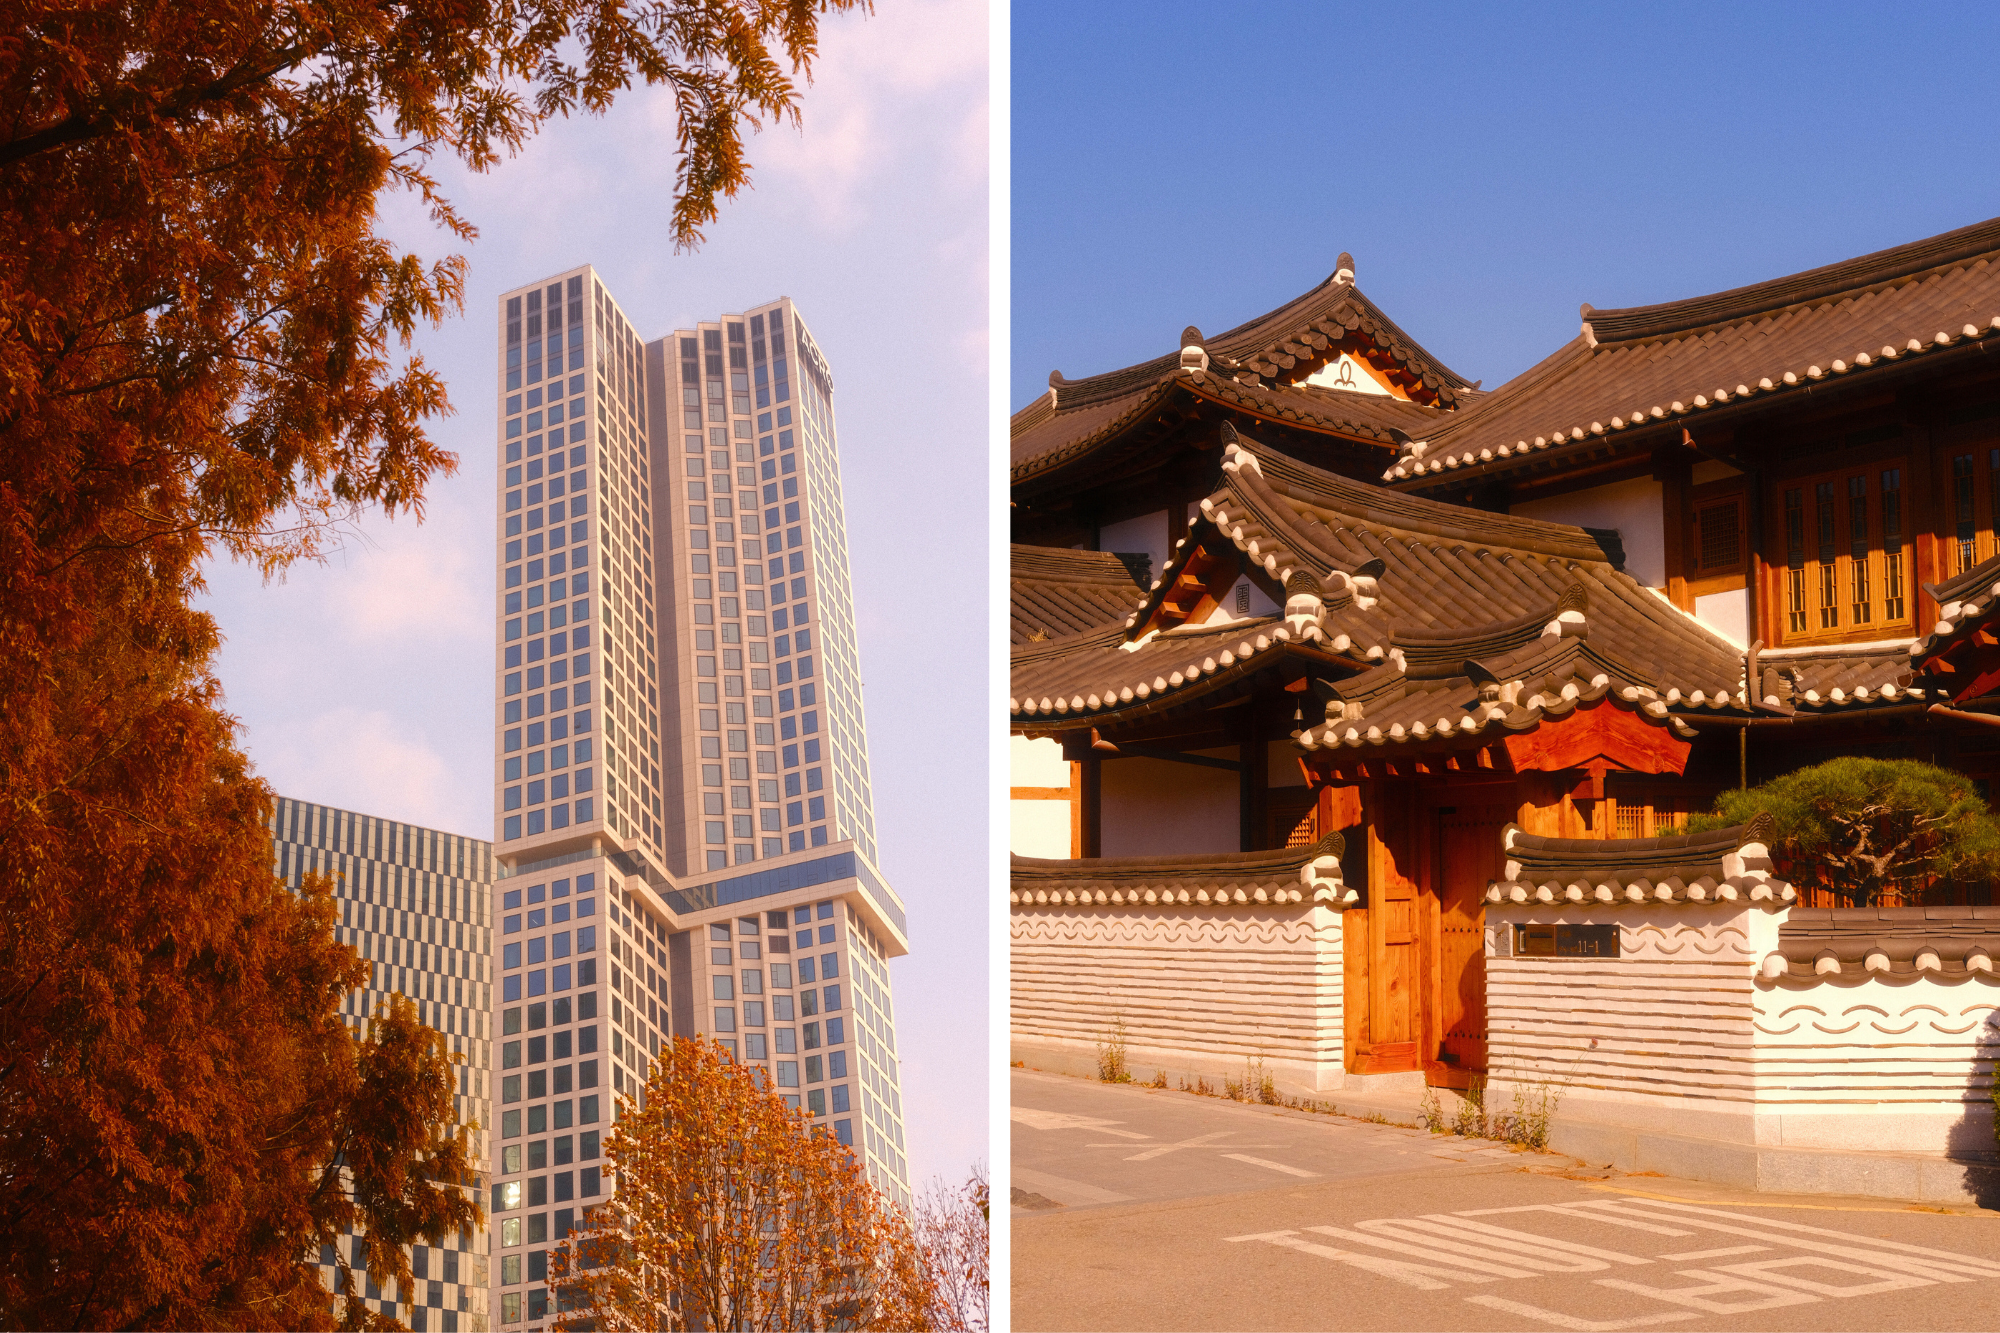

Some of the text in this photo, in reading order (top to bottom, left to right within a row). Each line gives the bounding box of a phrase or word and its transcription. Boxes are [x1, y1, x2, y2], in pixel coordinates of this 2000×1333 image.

[801, 328, 835, 393] ACRO
[1578, 940, 1599, 954] 11-1
[1222, 1197, 2000, 1332] 진입금지
